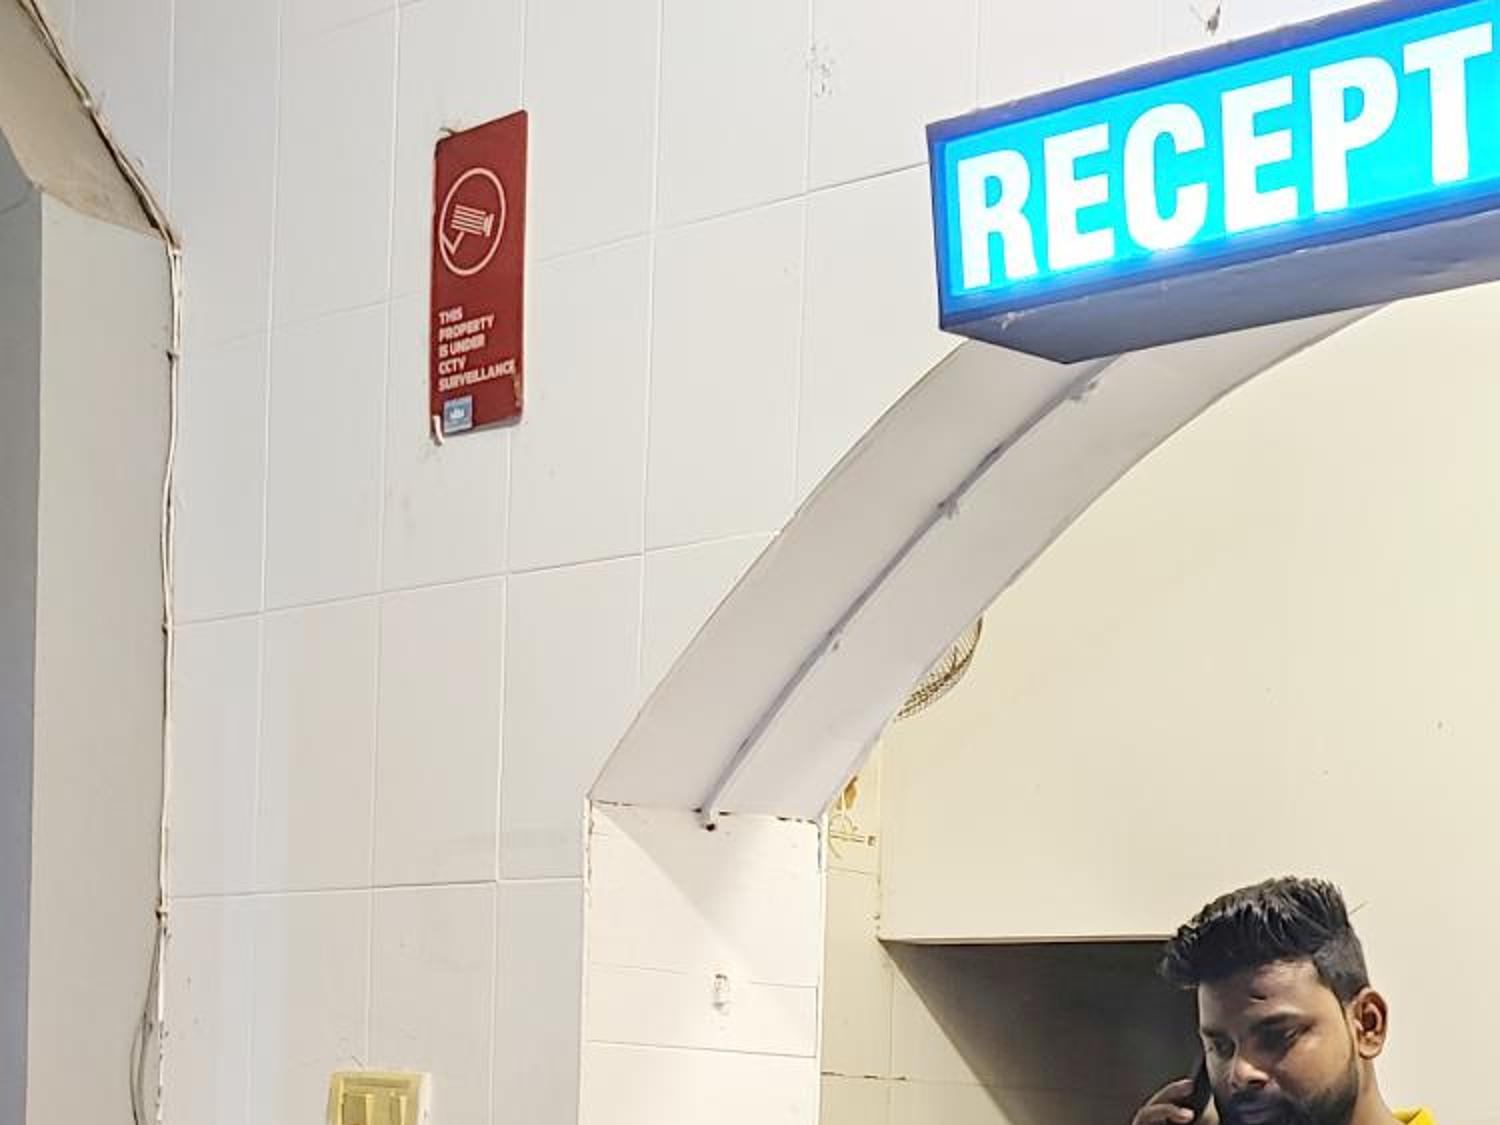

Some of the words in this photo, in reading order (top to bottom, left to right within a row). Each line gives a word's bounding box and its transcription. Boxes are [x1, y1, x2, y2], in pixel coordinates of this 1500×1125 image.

[439, 306, 462, 324] THIS
[439, 312, 495, 341] PROPERTY
[439, 344, 448, 358] IS
[450, 333, 485, 355] UNDER
[439, 355, 466, 375] CCTV
[439, 358, 515, 391] SURVEILLANCE
